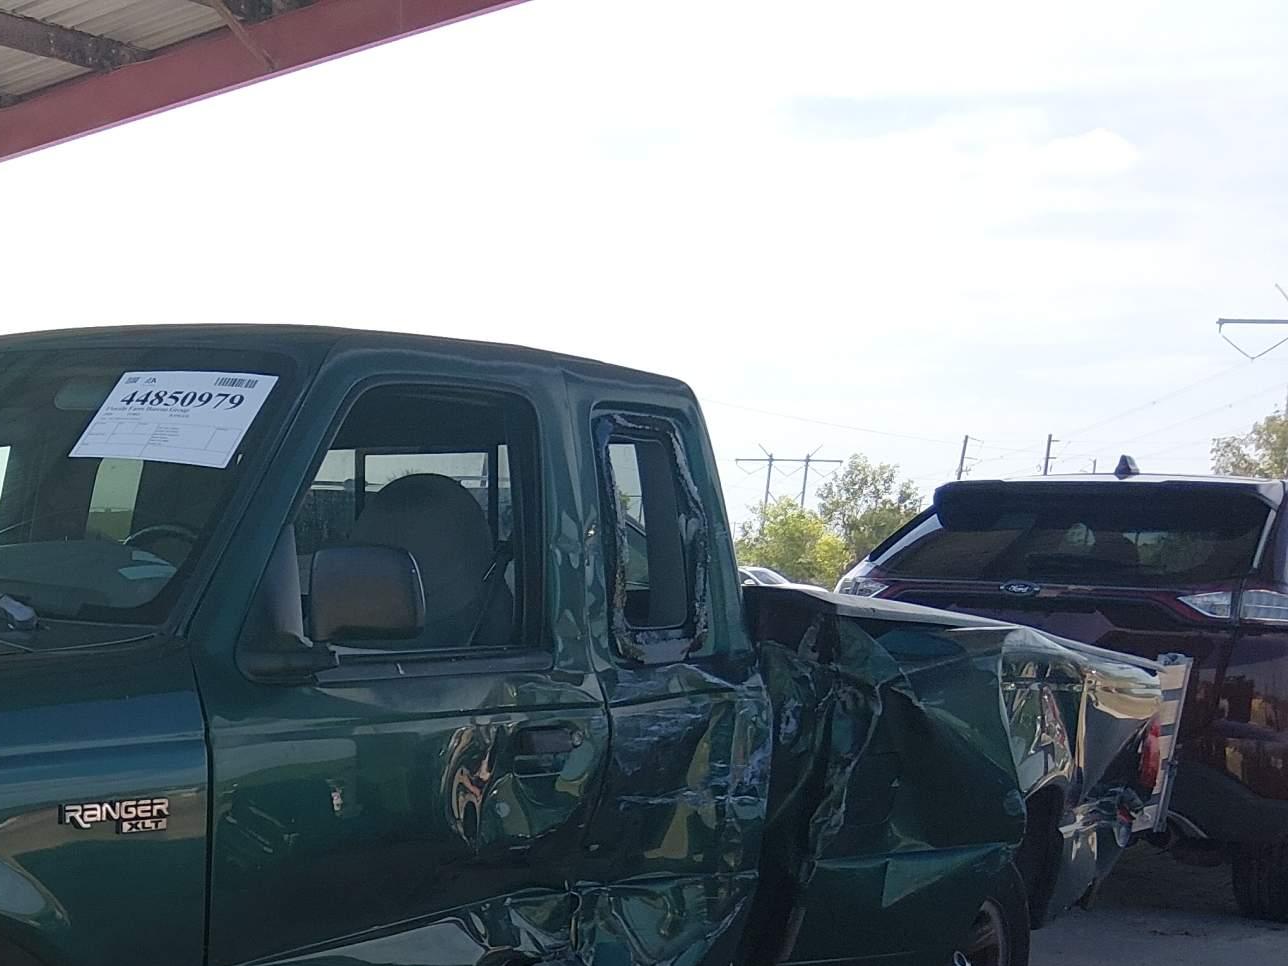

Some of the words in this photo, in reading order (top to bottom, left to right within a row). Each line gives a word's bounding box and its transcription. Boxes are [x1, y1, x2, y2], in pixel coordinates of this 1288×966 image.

[119, 390, 245, 411] 44850979
[65, 798, 169, 828] RANGER
[126, 819, 164, 832] XLT
